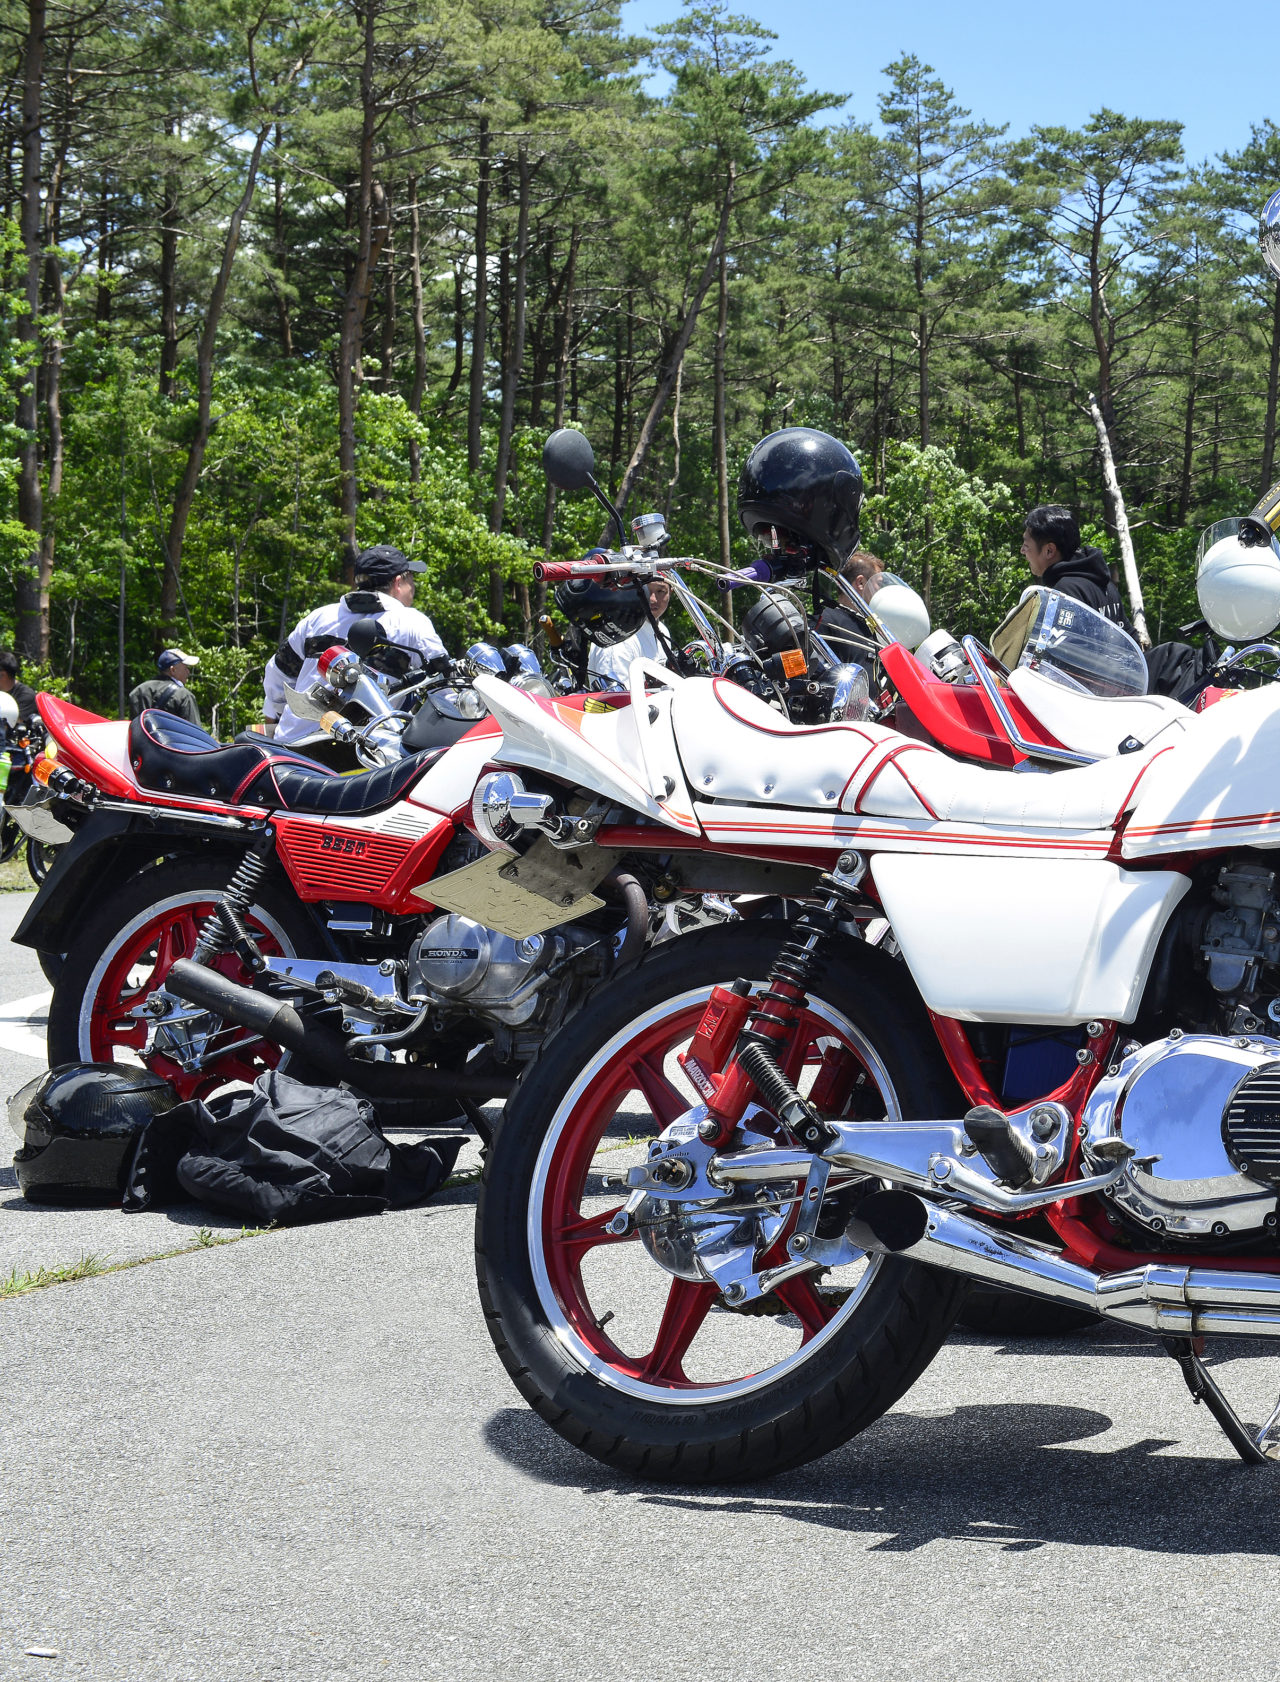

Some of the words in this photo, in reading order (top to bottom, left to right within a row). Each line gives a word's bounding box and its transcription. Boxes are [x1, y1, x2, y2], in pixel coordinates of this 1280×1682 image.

[320, 834, 367, 855] BEET
[427, 950, 469, 959] HONDA
[683, 1059, 717, 1100] MARZOCCHI
